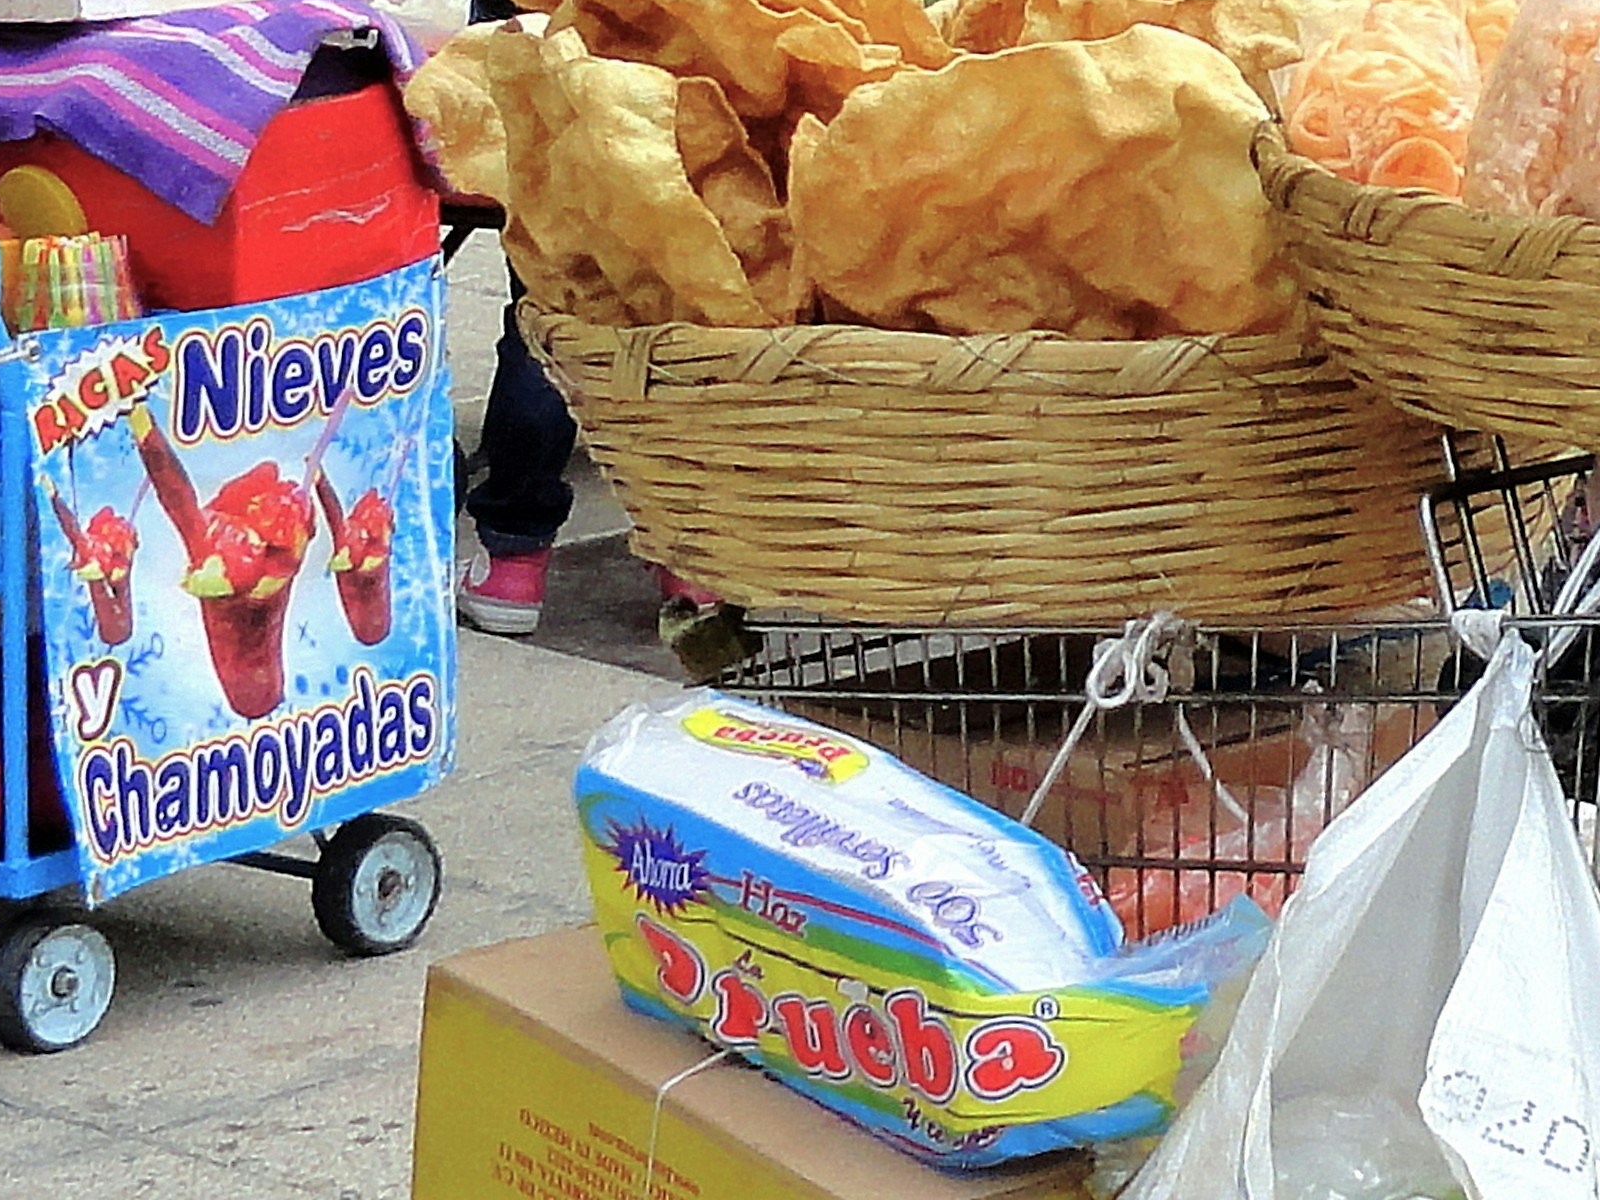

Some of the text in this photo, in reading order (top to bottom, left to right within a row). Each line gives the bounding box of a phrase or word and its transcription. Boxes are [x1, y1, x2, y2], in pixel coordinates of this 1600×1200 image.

[33, 308, 431, 453] RICAS Nieves
[72, 658, 122, 741] y
[78, 668, 437, 864] Chamoyadas
[738, 871, 807, 938] Haz
